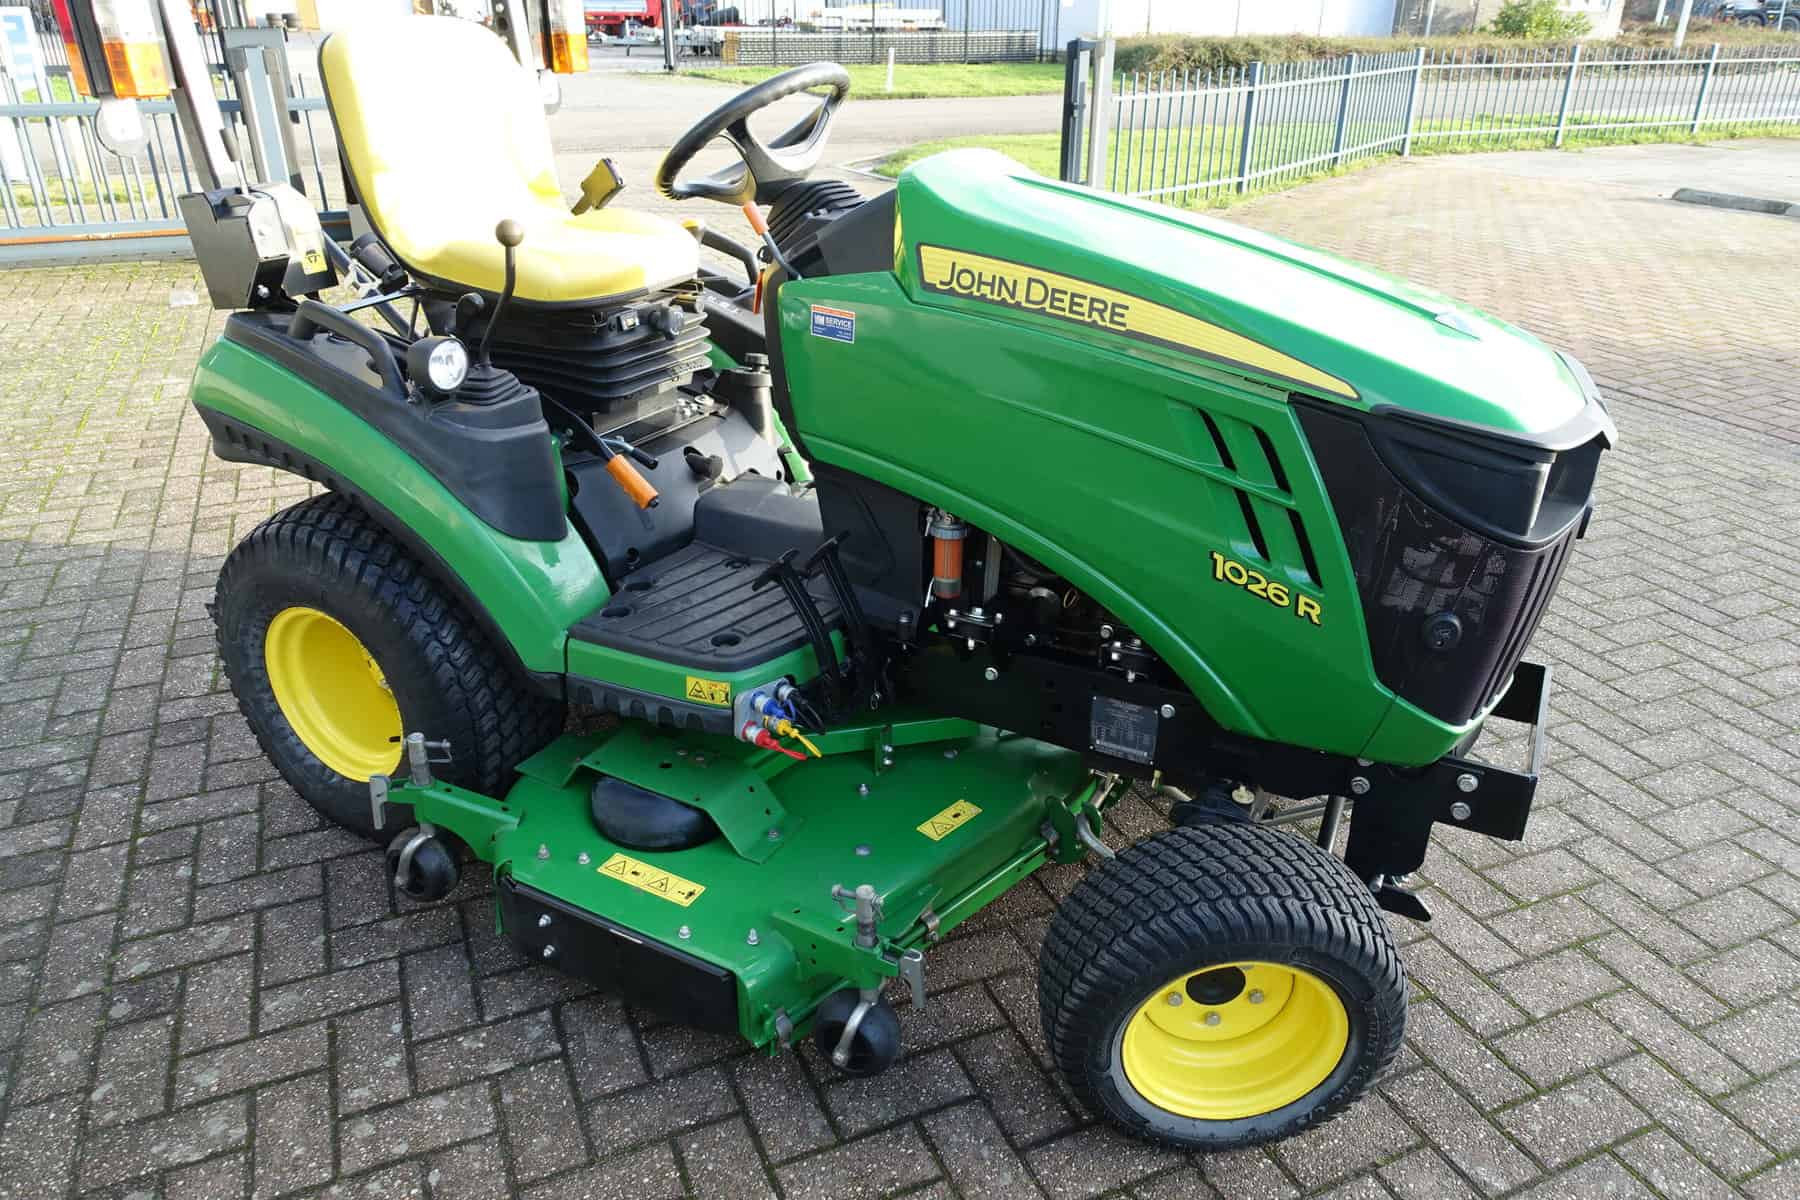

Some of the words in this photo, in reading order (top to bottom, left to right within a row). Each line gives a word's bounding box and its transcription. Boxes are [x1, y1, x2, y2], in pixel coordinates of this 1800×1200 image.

[825, 316, 853, 330] SERVICE
[938, 261, 1018, 300] JOHN
[1024, 277, 1130, 328] DEERE
[1211, 552, 1290, 608] 1026
[1297, 594, 1321, 625] R
